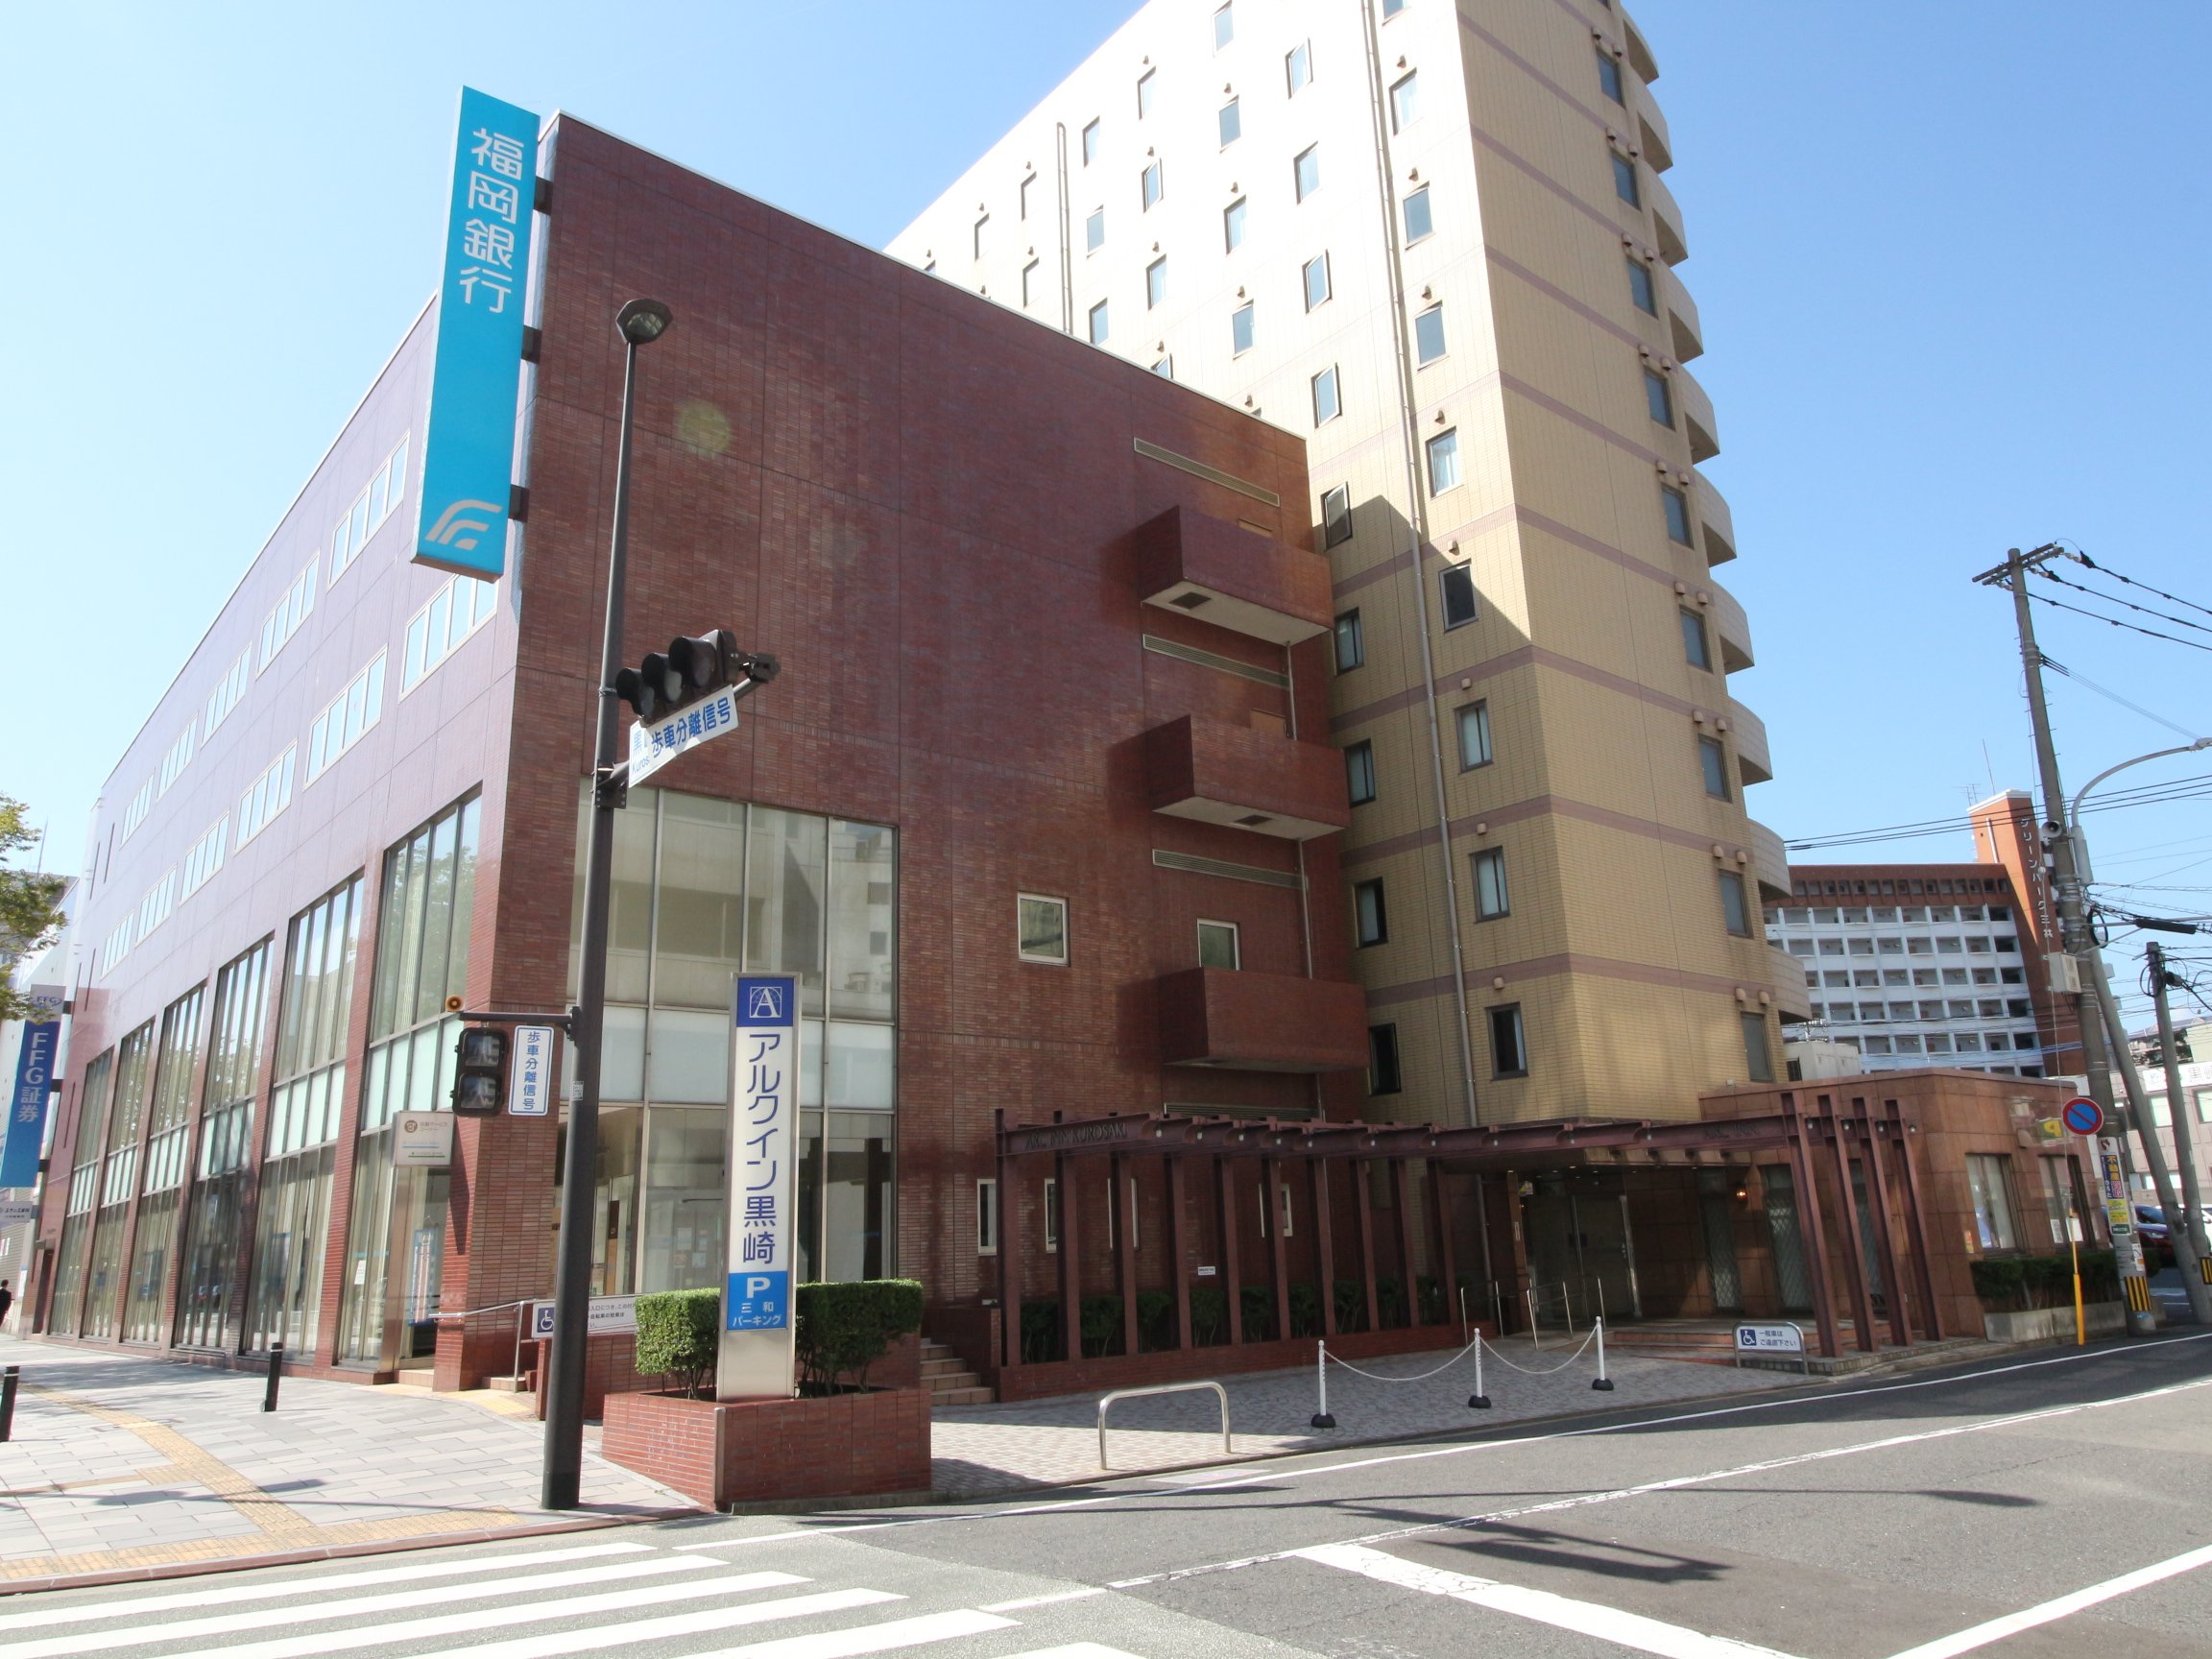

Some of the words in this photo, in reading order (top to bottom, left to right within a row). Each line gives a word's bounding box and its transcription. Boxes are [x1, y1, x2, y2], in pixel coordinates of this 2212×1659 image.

[459, 128, 524, 314] 福岡銀行
[651, 696, 731, 758] 歩車分離信号
[17, 1032, 49, 1122] FFG証券
[522, 1030, 541, 1111] 歩車分離信号
[742, 1033, 781, 1265] アルクイン黒崎
[733, 1314, 781, 1327] パーキング
[747, 1277, 771, 1299] P
